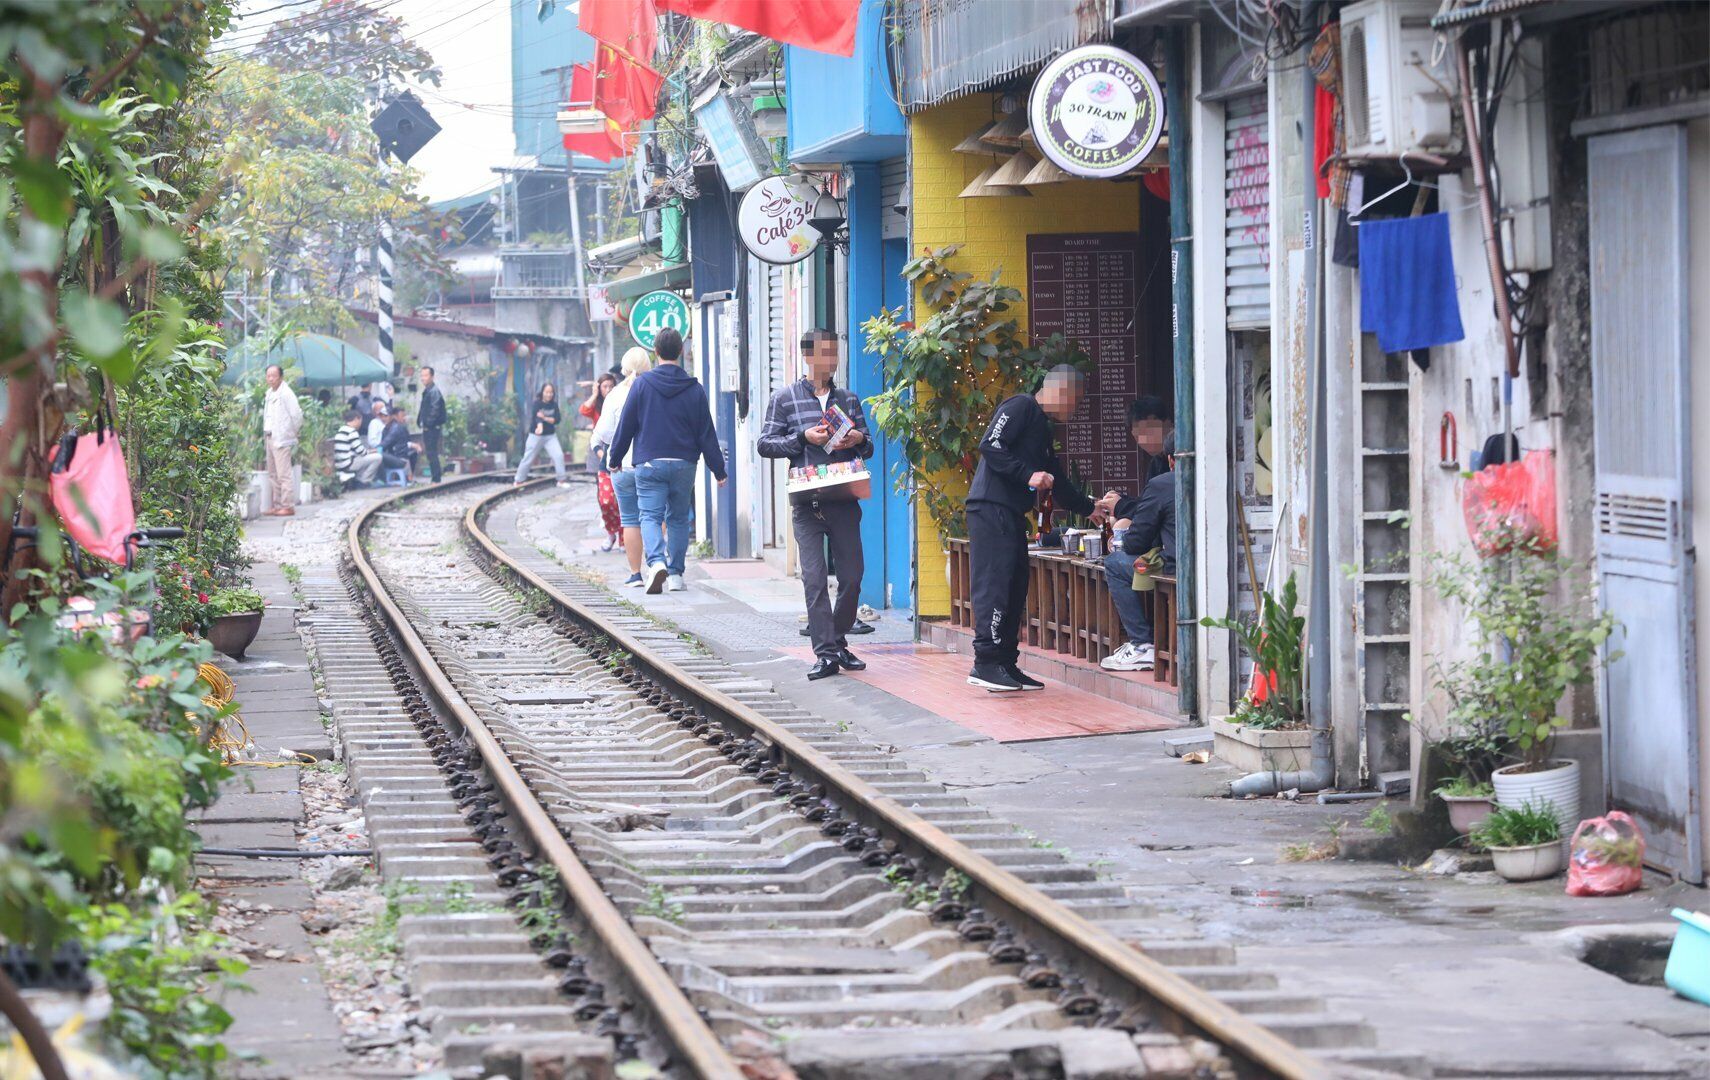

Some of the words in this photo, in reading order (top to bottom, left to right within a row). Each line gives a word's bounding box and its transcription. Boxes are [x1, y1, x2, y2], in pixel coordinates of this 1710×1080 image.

[1065, 60, 1102, 82] FAST
[1106, 62, 1142, 94] FOOD
[1069, 103, 1083, 112] 30
[1086, 105, 1127, 121] TRAIN
[1064, 139, 1120, 162] COFFEE
[757, 212, 796, 246] Café
[794, 201, 813, 226] 34
[644, 295, 677, 306] COFFEE
[637, 309, 682, 336] 40
[989, 412, 1010, 441] TERREX
